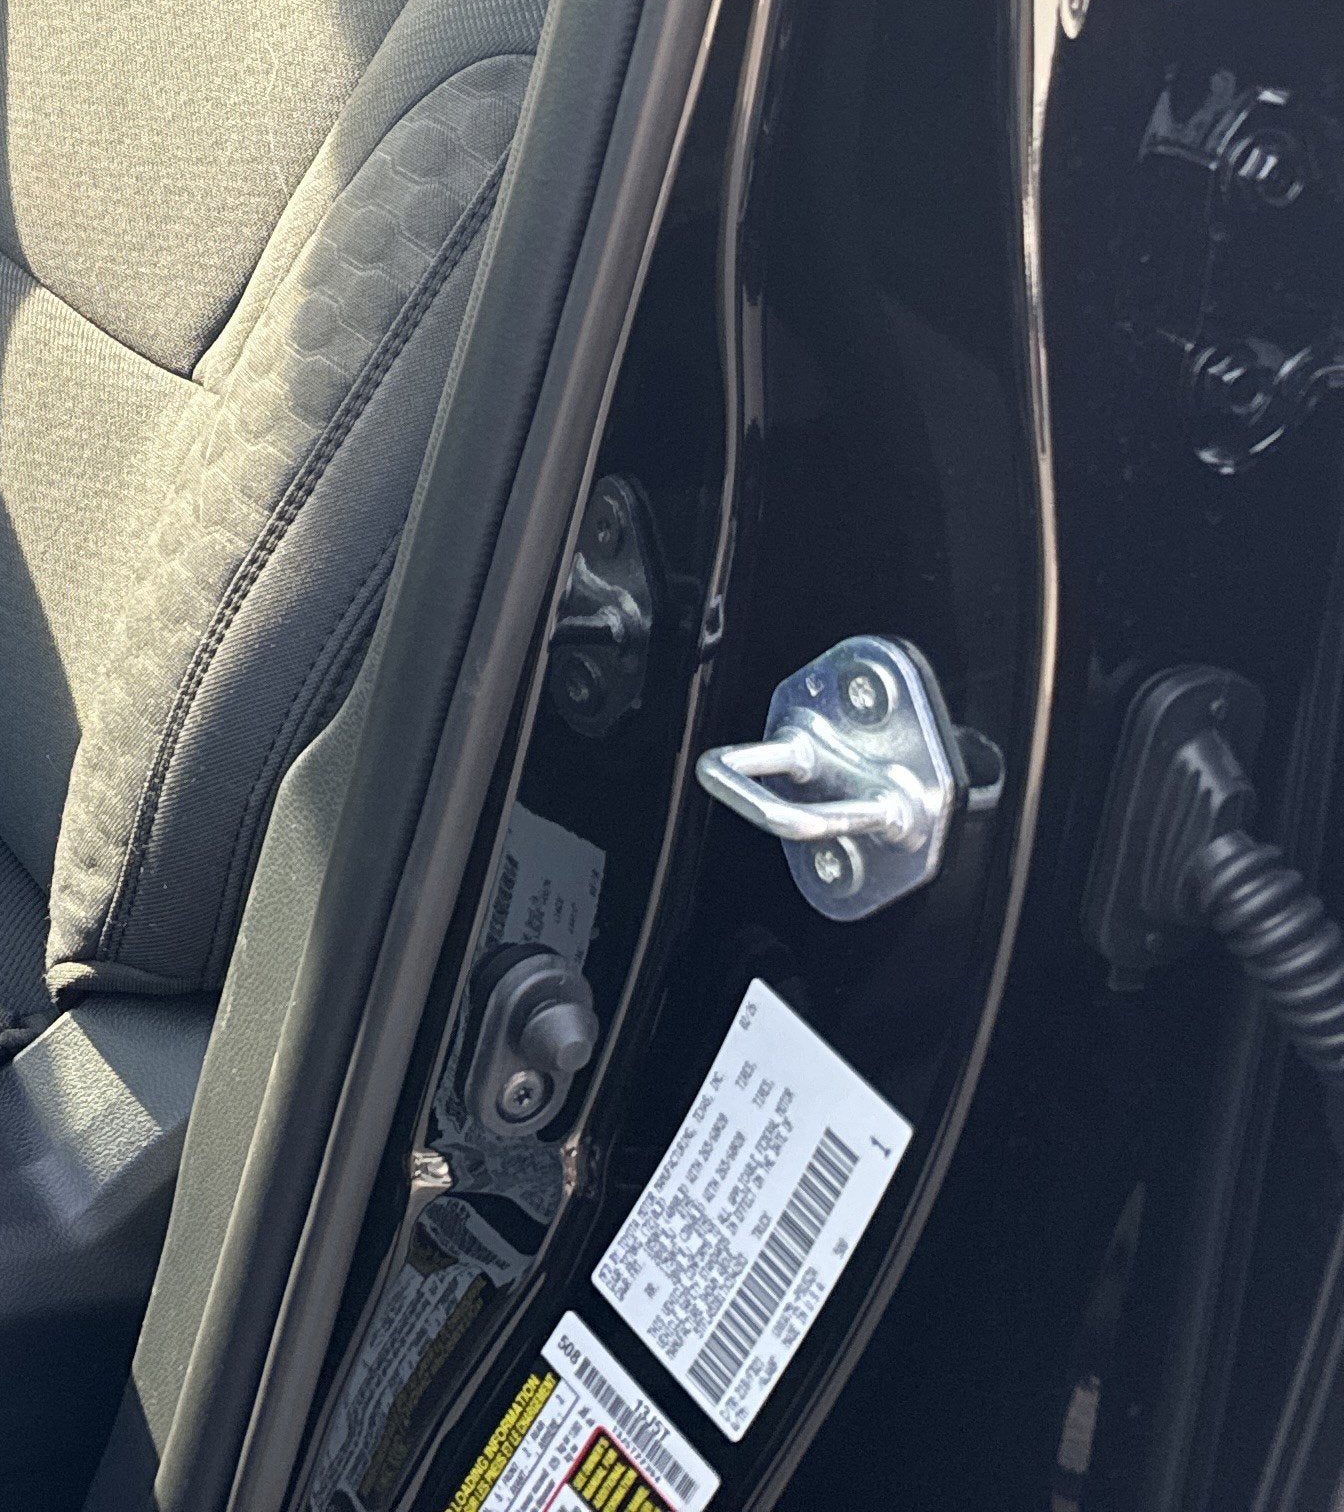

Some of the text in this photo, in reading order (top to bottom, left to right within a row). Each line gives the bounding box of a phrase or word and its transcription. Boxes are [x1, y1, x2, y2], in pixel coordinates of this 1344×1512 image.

[558, 1336, 582, 1364] 508
[449, 1372, 541, 1512] LOADING INFORMATION
